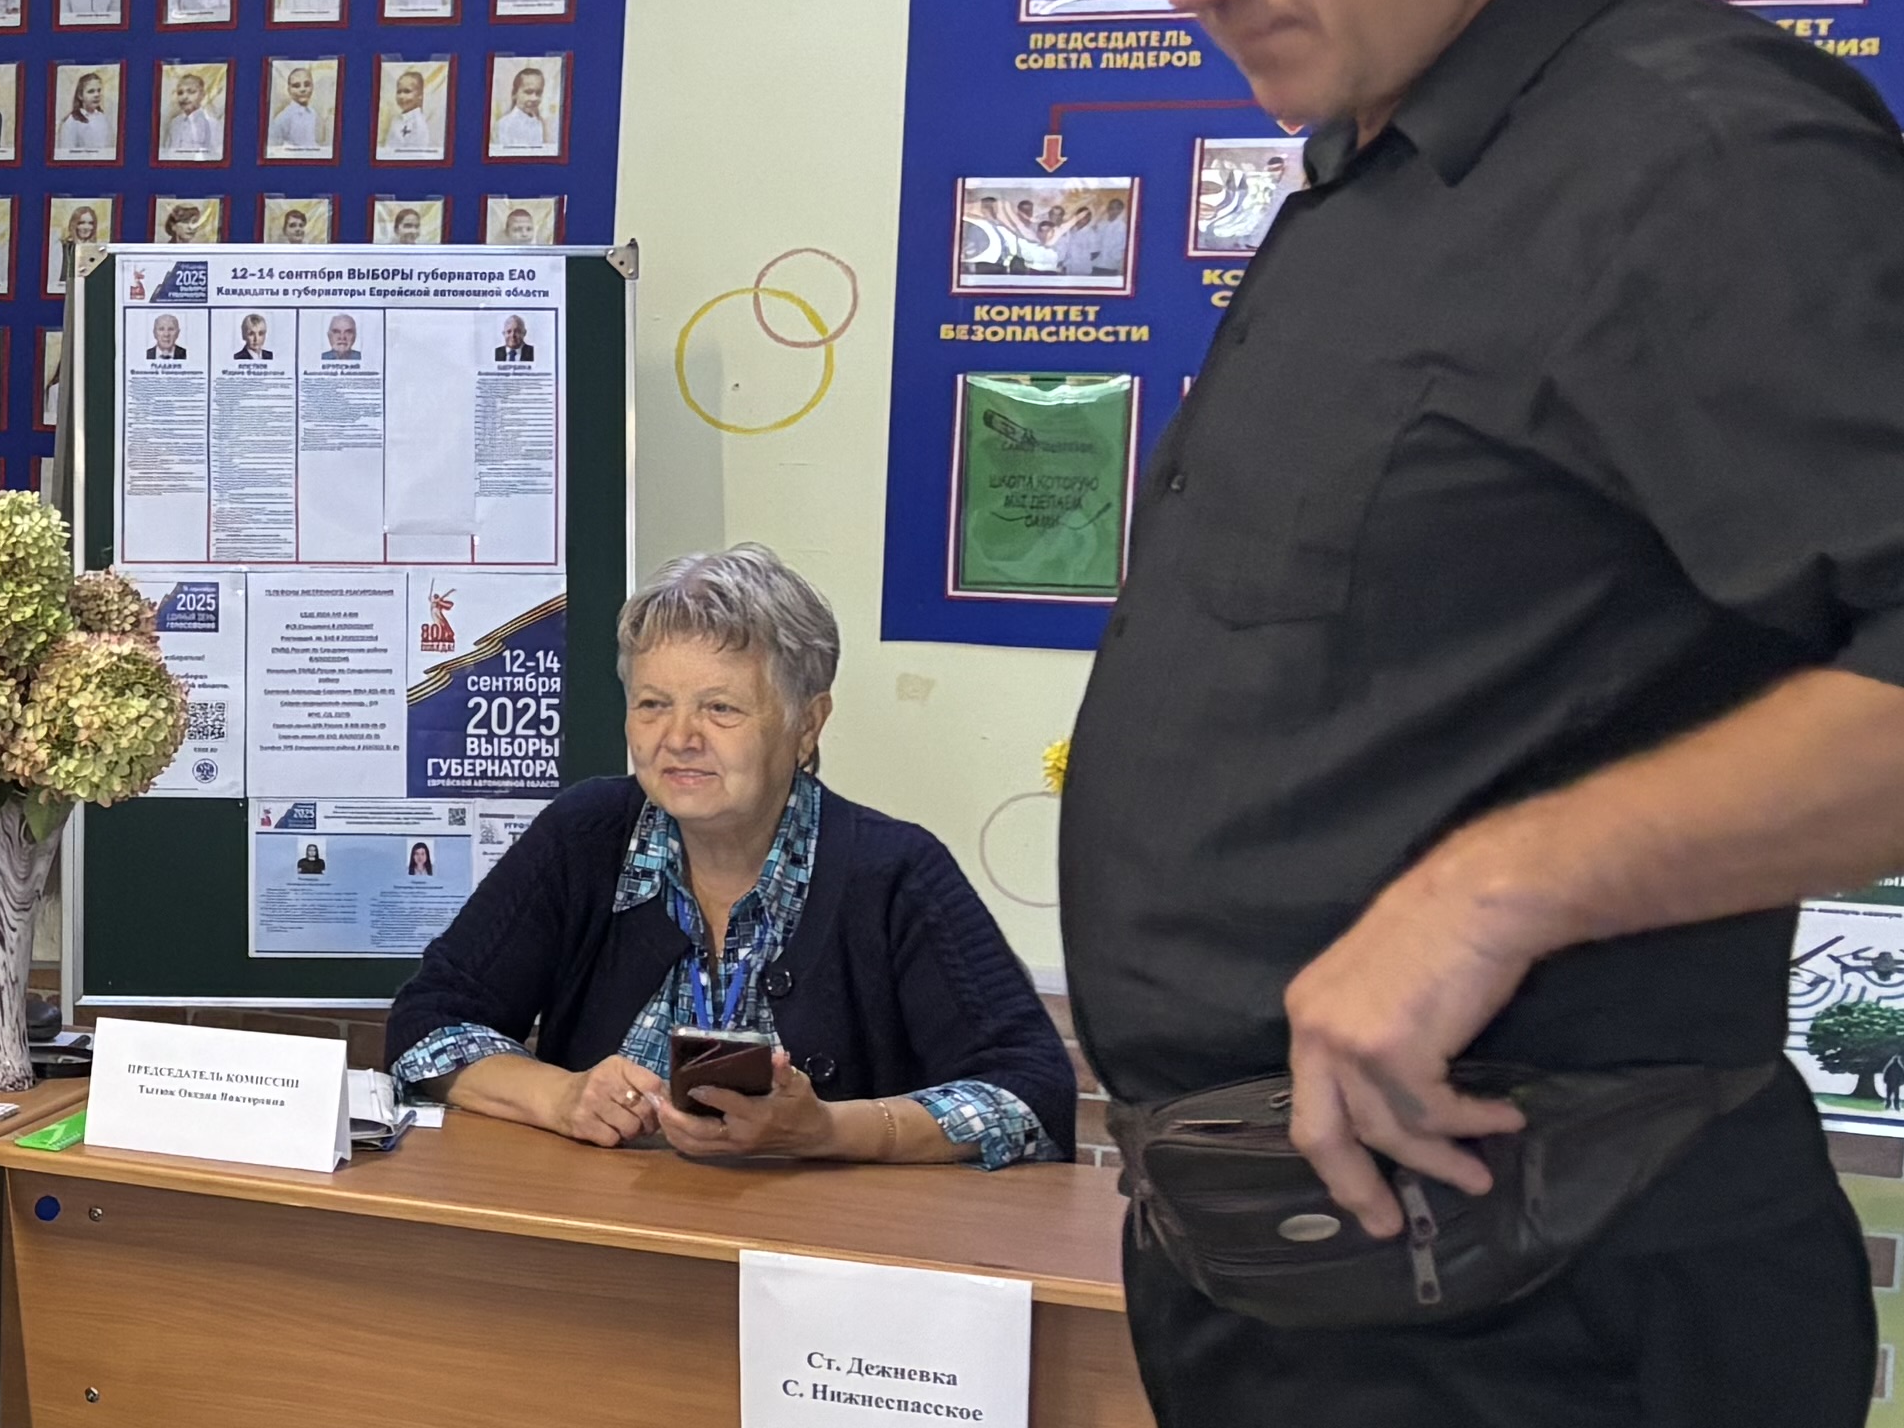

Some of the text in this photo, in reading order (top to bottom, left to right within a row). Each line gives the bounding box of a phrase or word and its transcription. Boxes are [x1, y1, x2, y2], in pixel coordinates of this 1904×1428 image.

[1030, 29, 1192, 52] ПРЕДСЕДАТЕЛЬ
[1014, 47, 1202, 71] СОВЕТА ЛИДЕРОВ
[175, 270, 207, 286] 2025
[278, 268, 343, 282] сентября
[348, 268, 413, 280] ВЫБОРЫ
[417, 269, 505, 283] губернатора
[509, 269, 536, 281] ЕАО
[217, 287, 279, 298] Кандидаты
[292, 287, 366, 299] губернаторы
[370, 286, 430, 298] Еврейской
[433, 287, 502, 298] автономной
[504, 287, 549, 298] области
[974, 305, 1100, 324] КОМИТЕТ
[939, 324, 1150, 345] БЕЗОПАСНОСТИ
[176, 593, 217, 611] 2025
[502, 649, 561, 673] 12-14
[467, 673, 561, 696] сентября
[466, 697, 560, 736] 2025
[466, 737, 559, 757] ВЫБОРЫ
[427, 758, 559, 778] ГУБЕРНАТОРА
[128, 1063, 299, 1089] ПРЕДСЕДАТЕЛЬ КОМИССИИ
[806, 1350, 958, 1387] Ст. Дежневка
[782, 1379, 804, 1399] С.
